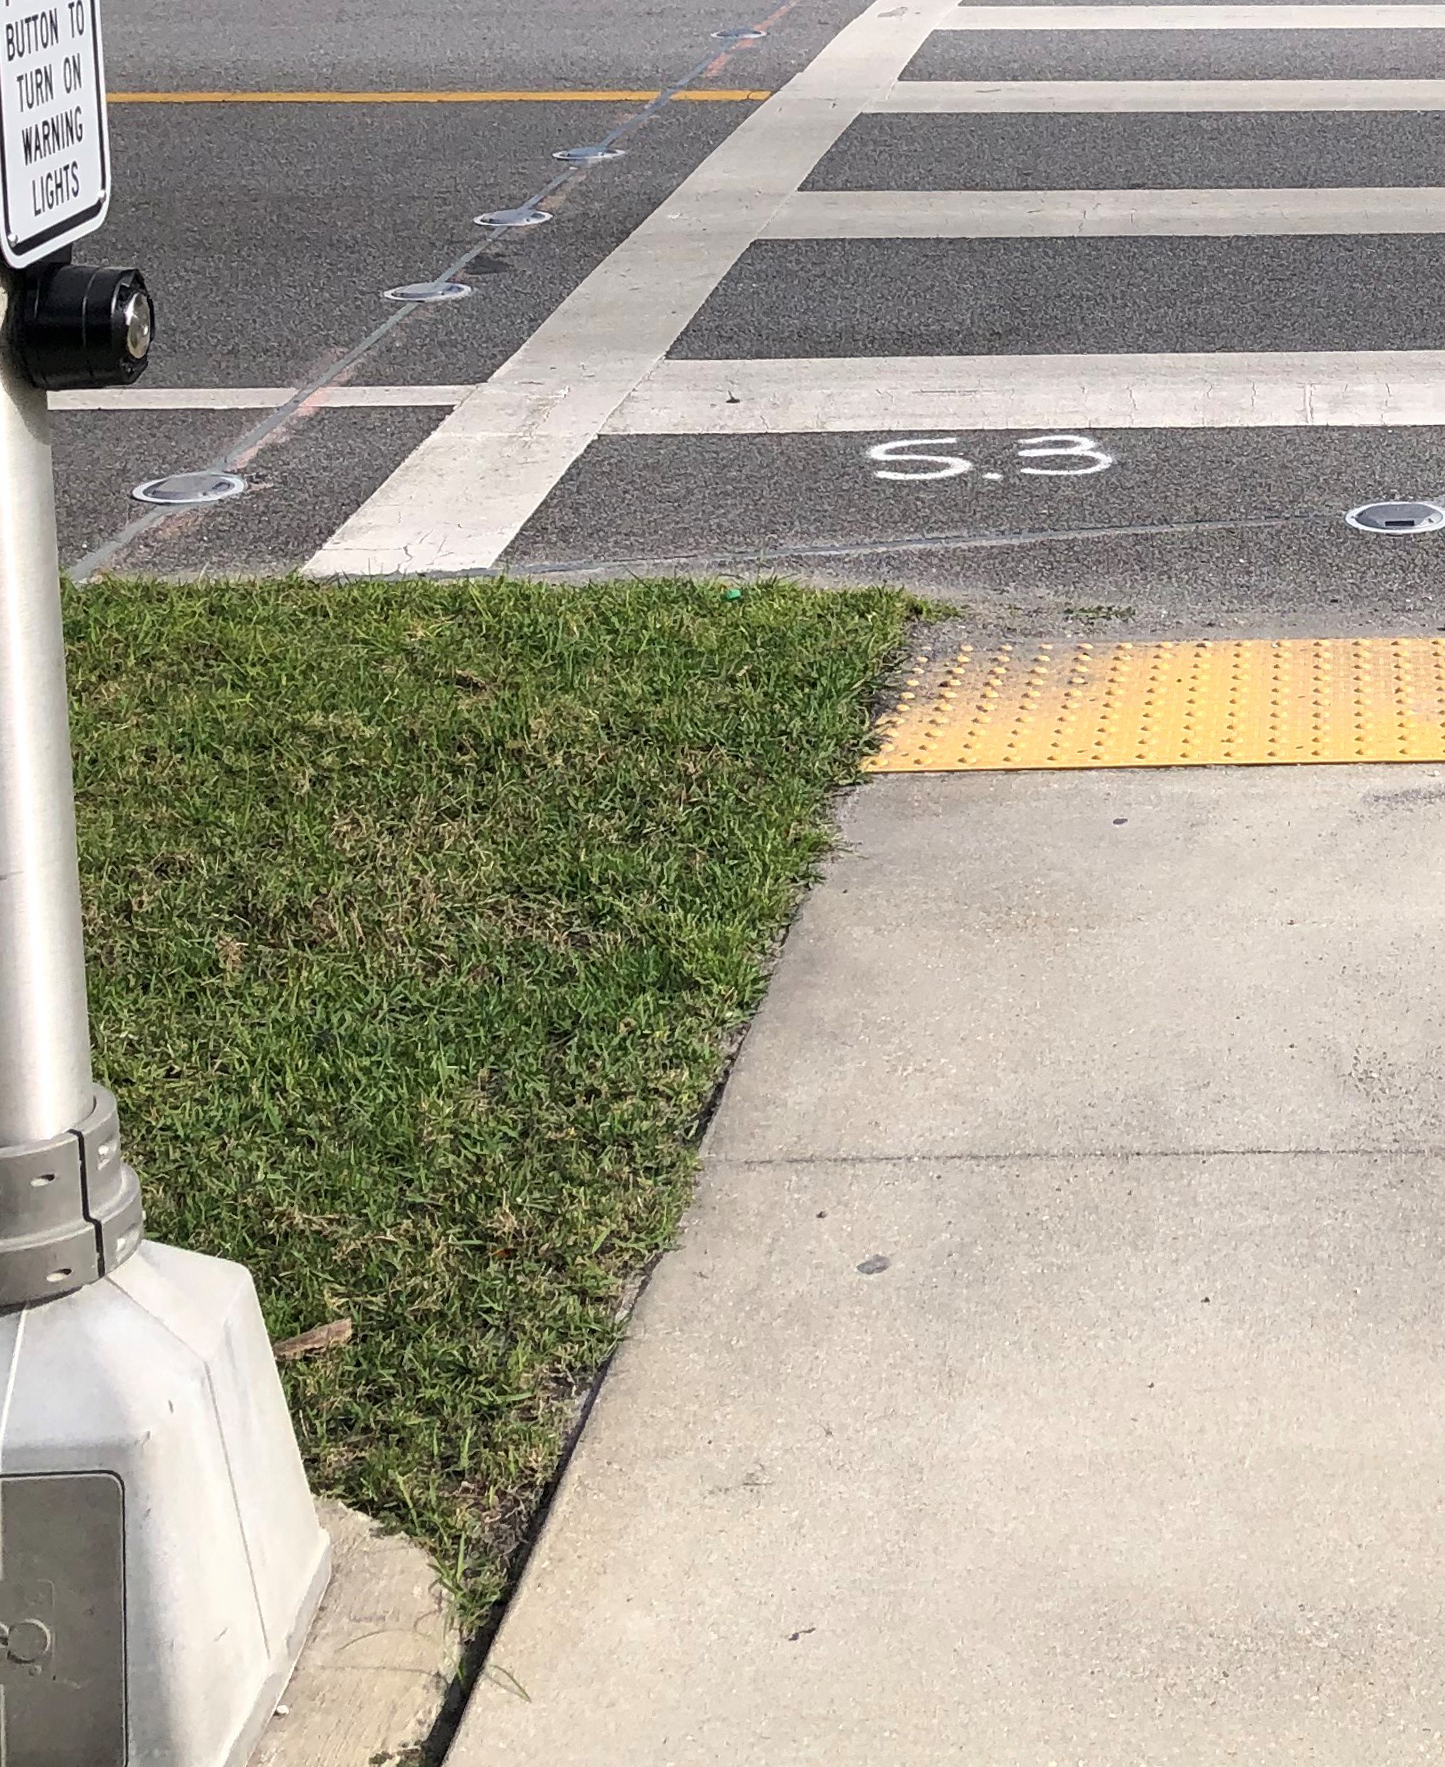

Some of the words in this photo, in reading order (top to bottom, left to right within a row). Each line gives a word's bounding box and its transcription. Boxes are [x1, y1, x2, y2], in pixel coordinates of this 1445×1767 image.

[6, 8, 59, 62] BUTTON
[68, 0, 85, 38] TO
[16, 63, 54, 112] TURN
[63, 52, 82, 94] ON
[22, 105, 83, 166] WARNING
[32, 160, 80, 217] LIGHTS
